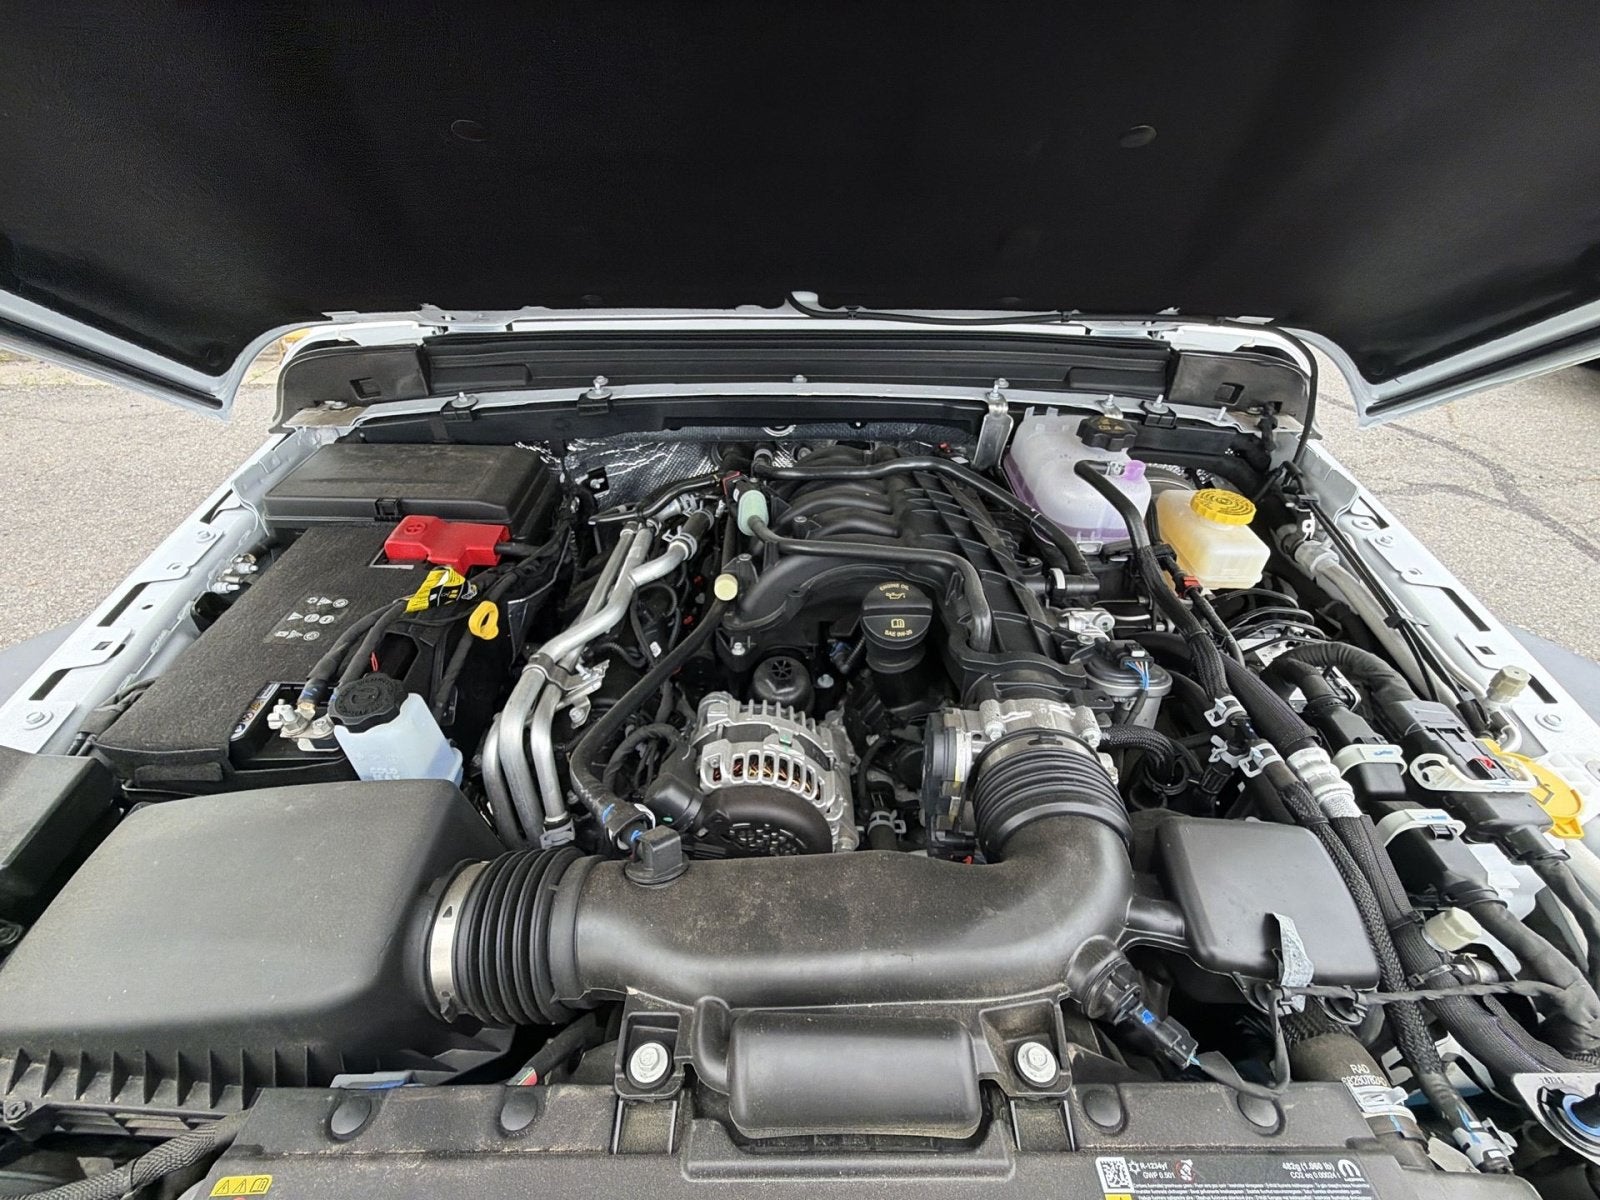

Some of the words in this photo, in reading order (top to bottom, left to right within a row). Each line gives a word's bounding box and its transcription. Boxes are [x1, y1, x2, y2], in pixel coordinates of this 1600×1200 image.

[879, 583, 899, 591] ENGINE
[900, 583, 910, 591] OIL
[884, 629, 896, 637] SAE
[1349, 1063, 1370, 1074] RAD
[1142, 1171, 1158, 1179] GWP
[1159, 1171, 1176, 1179] 0.501
[1289, 1171, 1305, 1179] CO2
